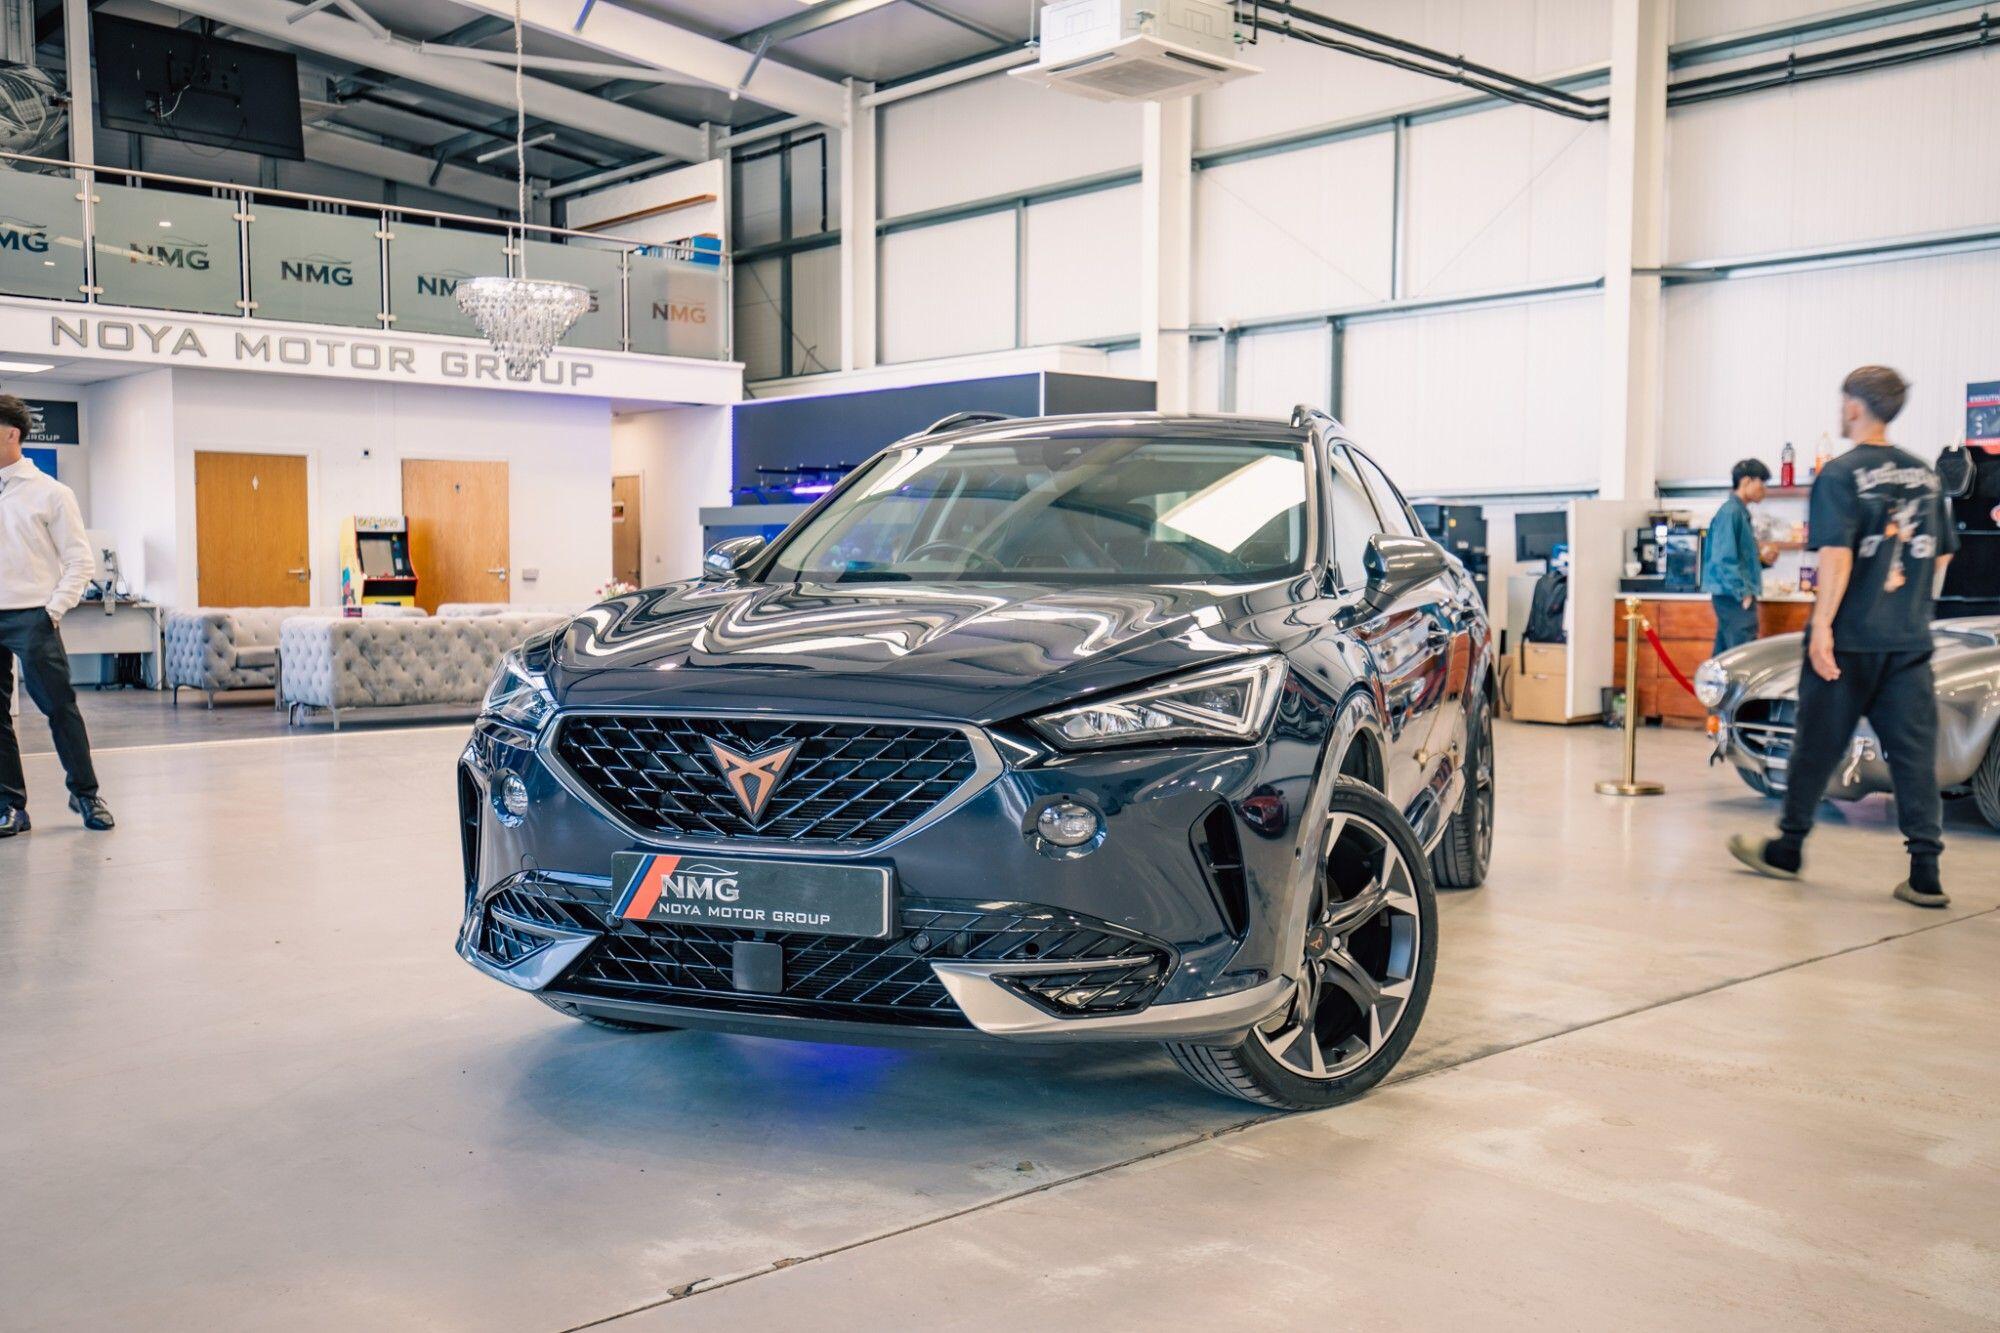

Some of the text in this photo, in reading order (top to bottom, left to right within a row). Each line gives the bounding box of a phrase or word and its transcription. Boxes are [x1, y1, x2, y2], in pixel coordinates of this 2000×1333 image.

[0, 230, 49, 253] MG
[130, 242, 210, 270] NMG
[281, 261, 353, 286] NMG
[417, 275, 459, 297] NM
[652, 302, 706, 323] NMG
[52, 316, 207, 358] NOYA
[235, 332, 416, 374] MOTOR
[660, 874, 740, 902] NMG
[659, 902, 831, 925] NOYA MOTOR GROUP
